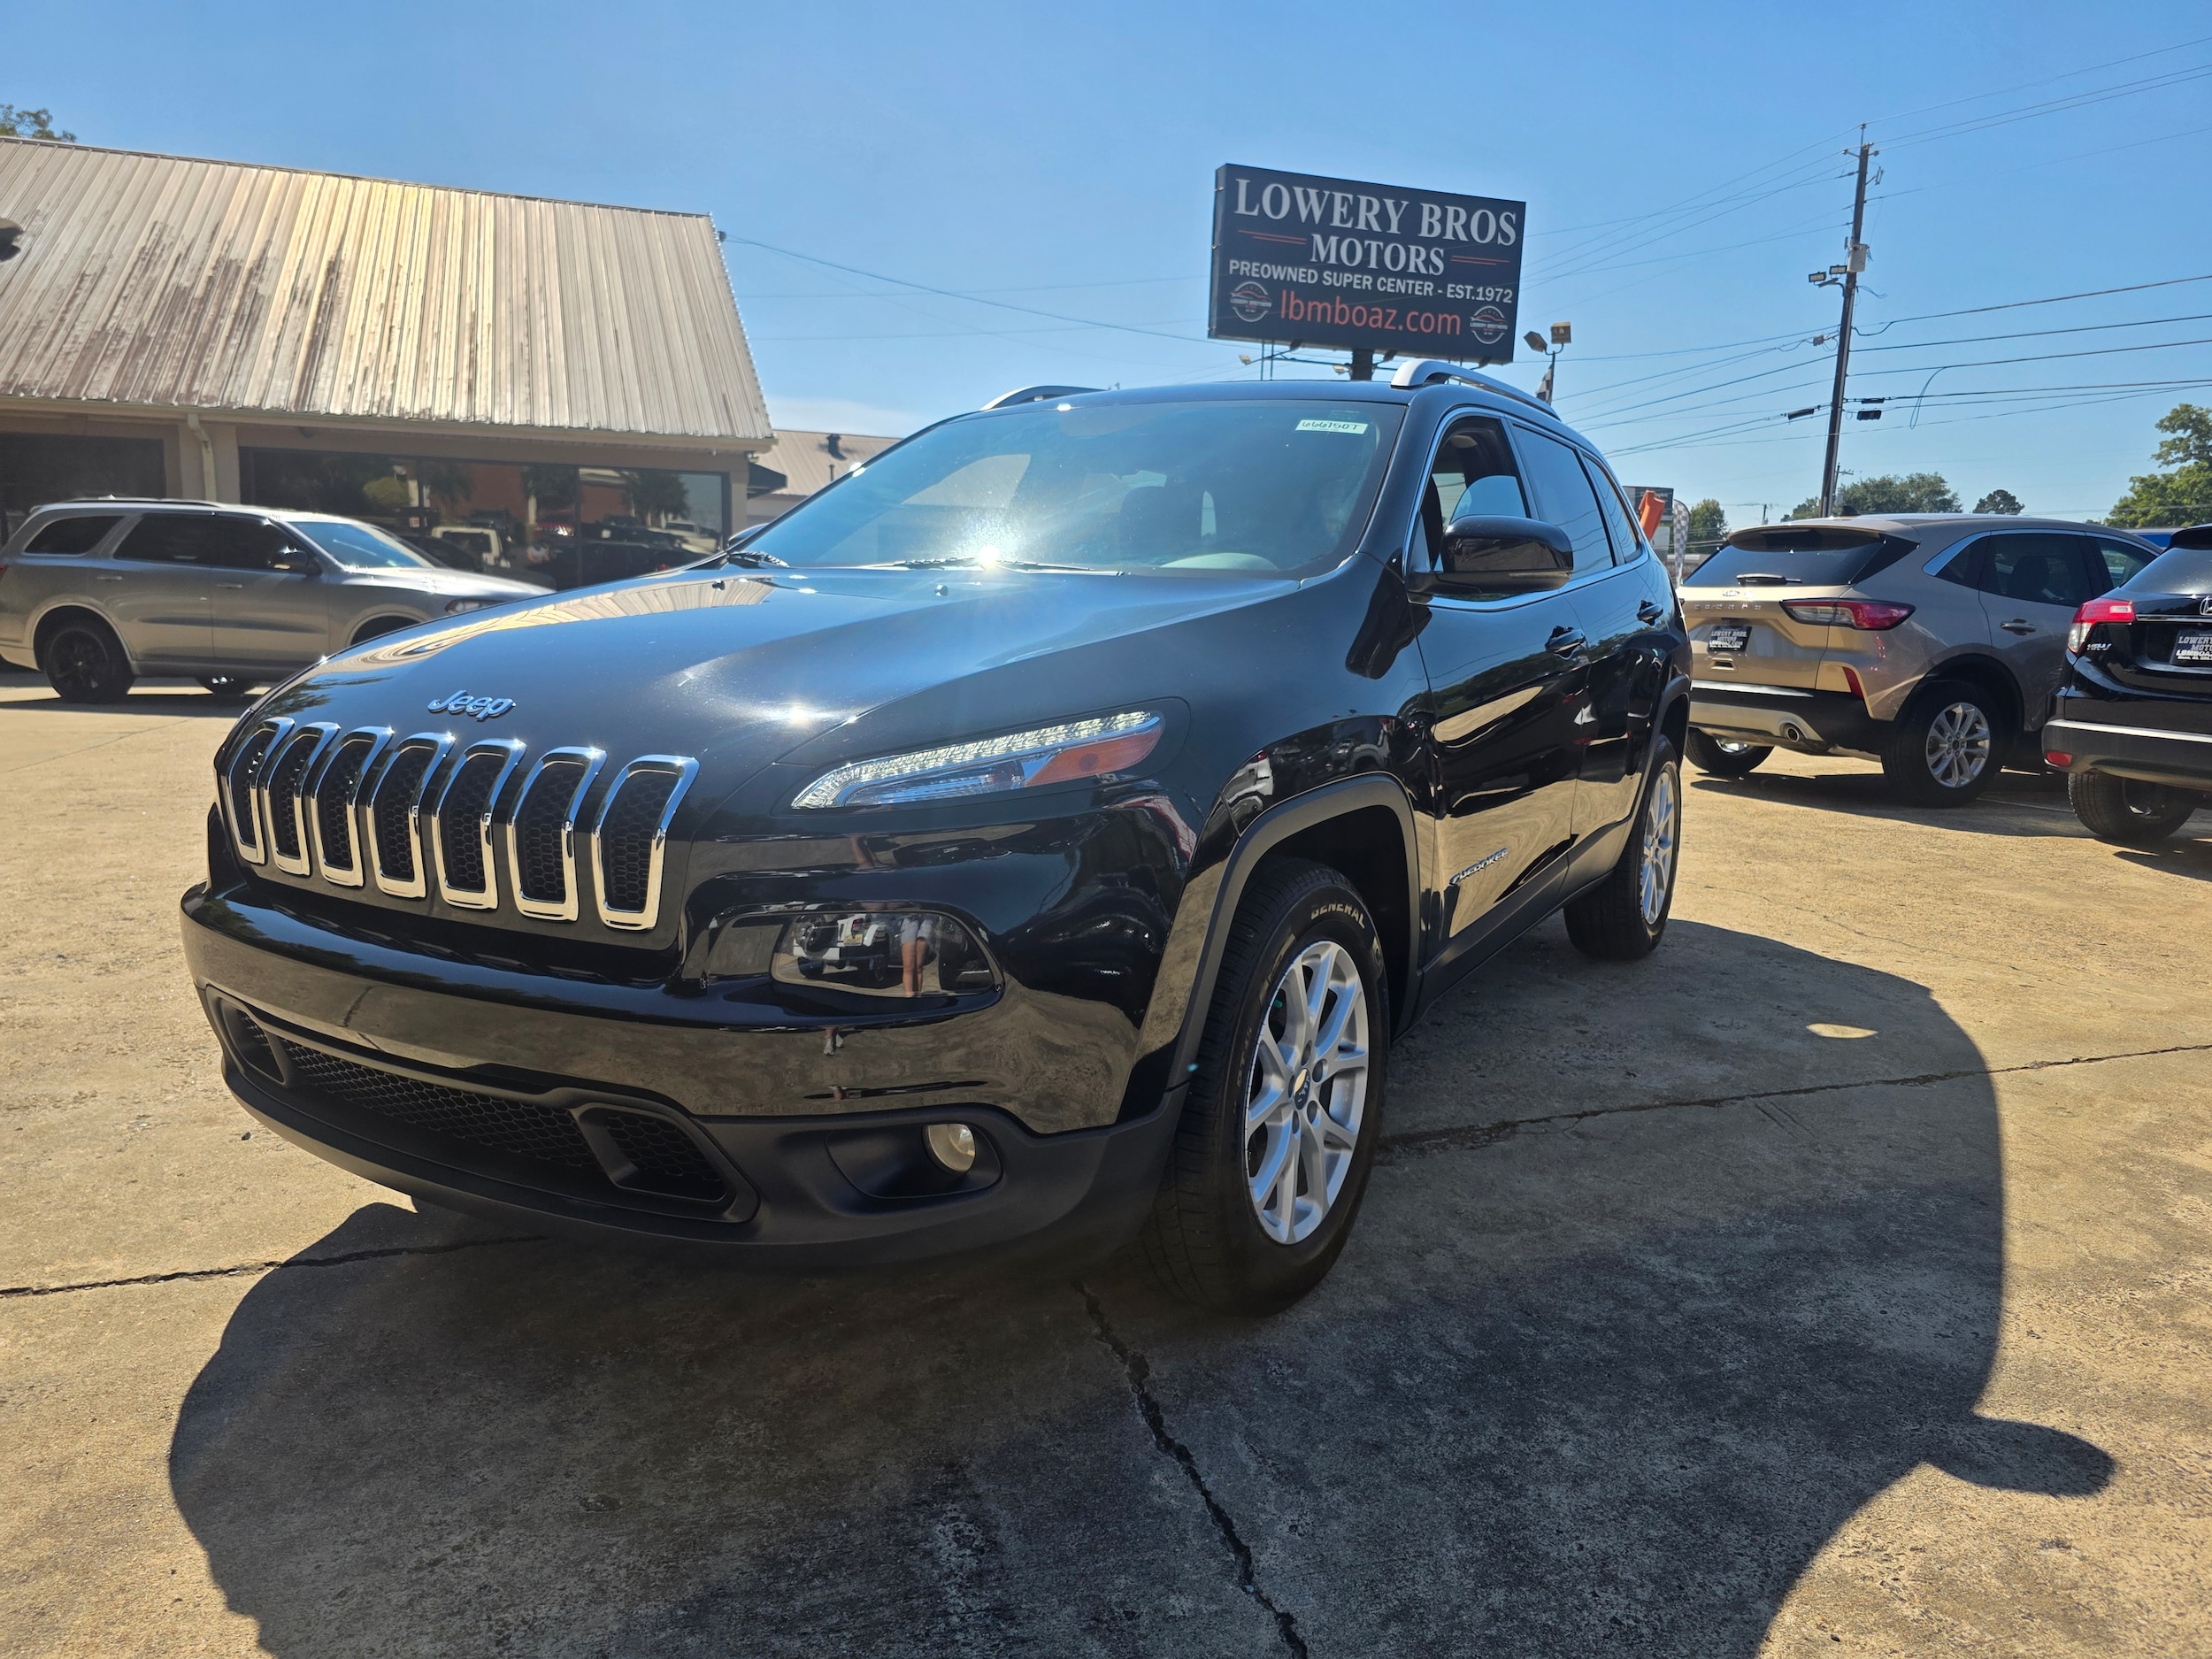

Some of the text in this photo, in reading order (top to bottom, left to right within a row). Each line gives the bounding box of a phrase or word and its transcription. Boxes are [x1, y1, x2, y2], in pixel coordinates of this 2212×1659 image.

[1233, 179, 1517, 246] LOWERY BROS
[1310, 234, 1444, 275] MOTORS
[1229, 259, 1318, 284] PREOWNED
[1322, 271, 1372, 290] SUPER
[1377, 277, 1433, 296] CENTER
[1447, 283, 1513, 303] EST.1972
[1281, 289, 1460, 335] lbmboaz.com
[427, 689, 517, 721] Jeep
